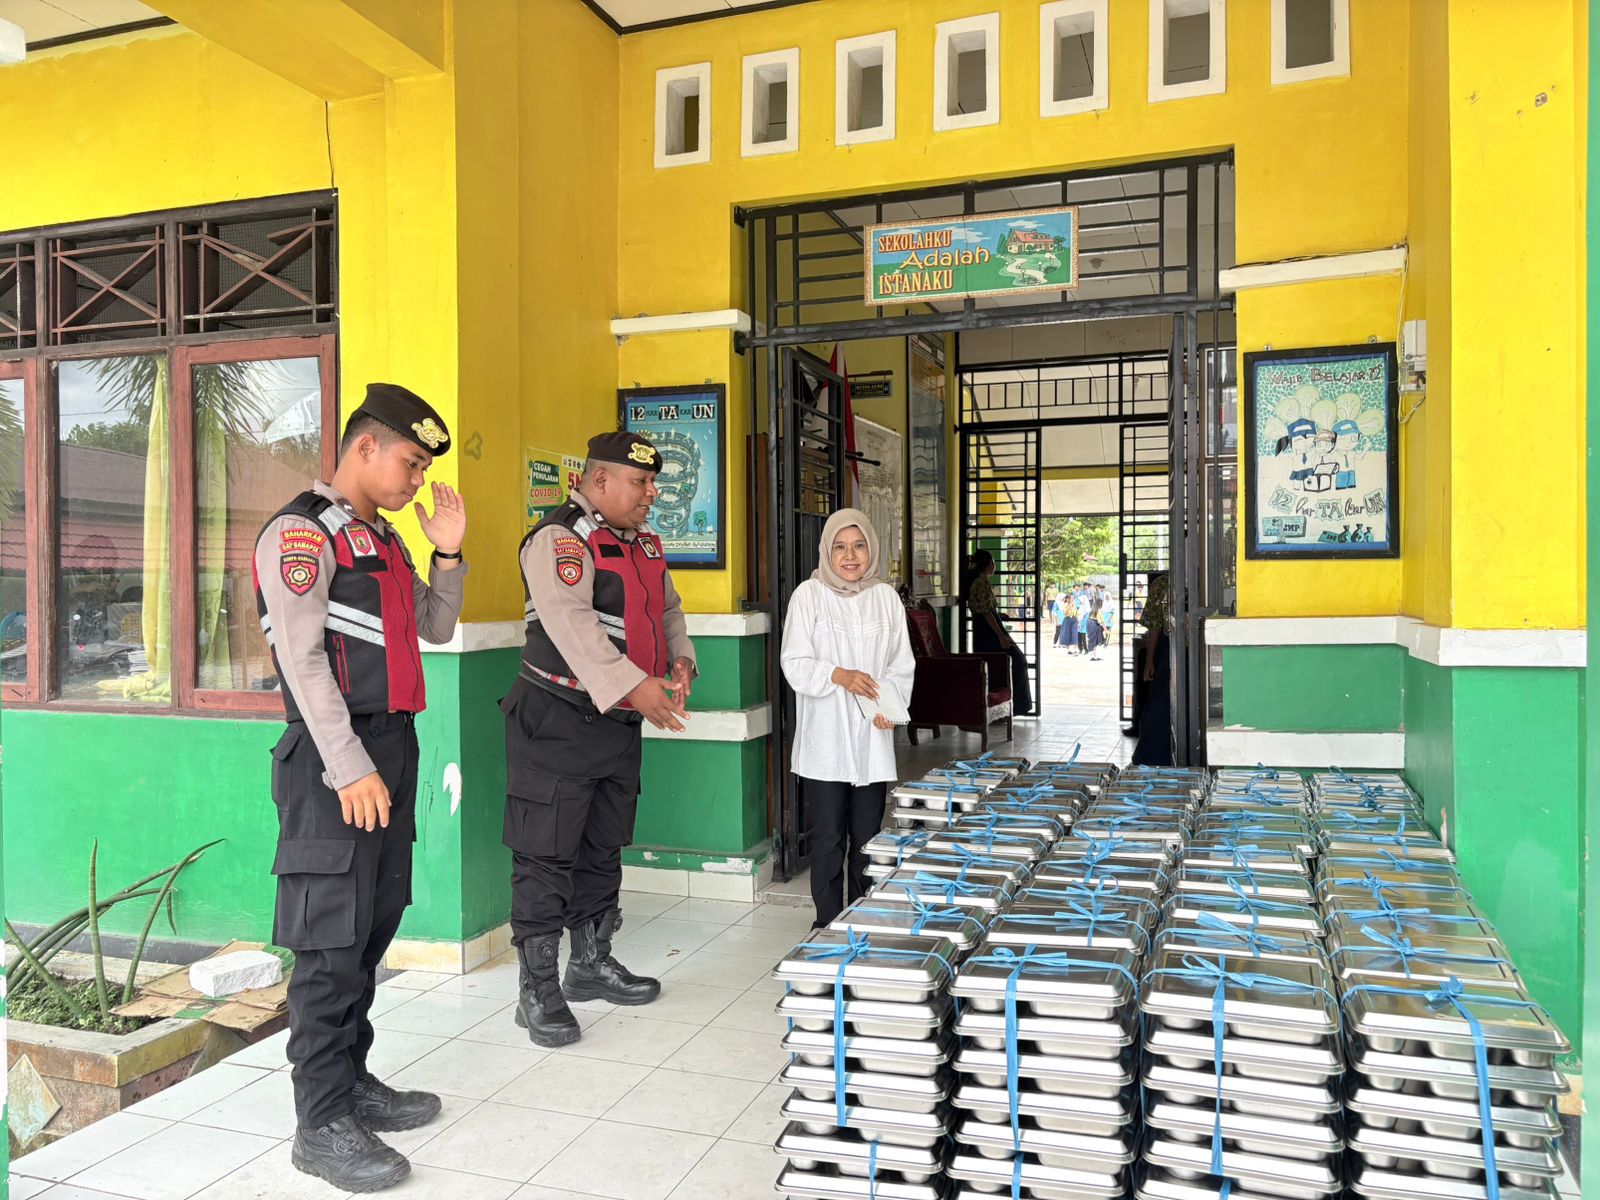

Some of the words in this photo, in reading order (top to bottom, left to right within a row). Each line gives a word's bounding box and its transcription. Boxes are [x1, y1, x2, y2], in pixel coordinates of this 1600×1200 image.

[878, 230, 952, 253] SEKOLAHKU
[900, 246, 990, 270] Adalah
[878, 270, 953, 295] ISTANAKU
[630, 406, 646, 421] 12
[659, 406, 678, 420] TA
[692, 404, 715, 419] UN
[533, 462, 552, 474] CEGAH
[530, 488, 552, 498] COVID
[554, 487, 562, 497] 19
[1318, 502, 1342, 519] TA
